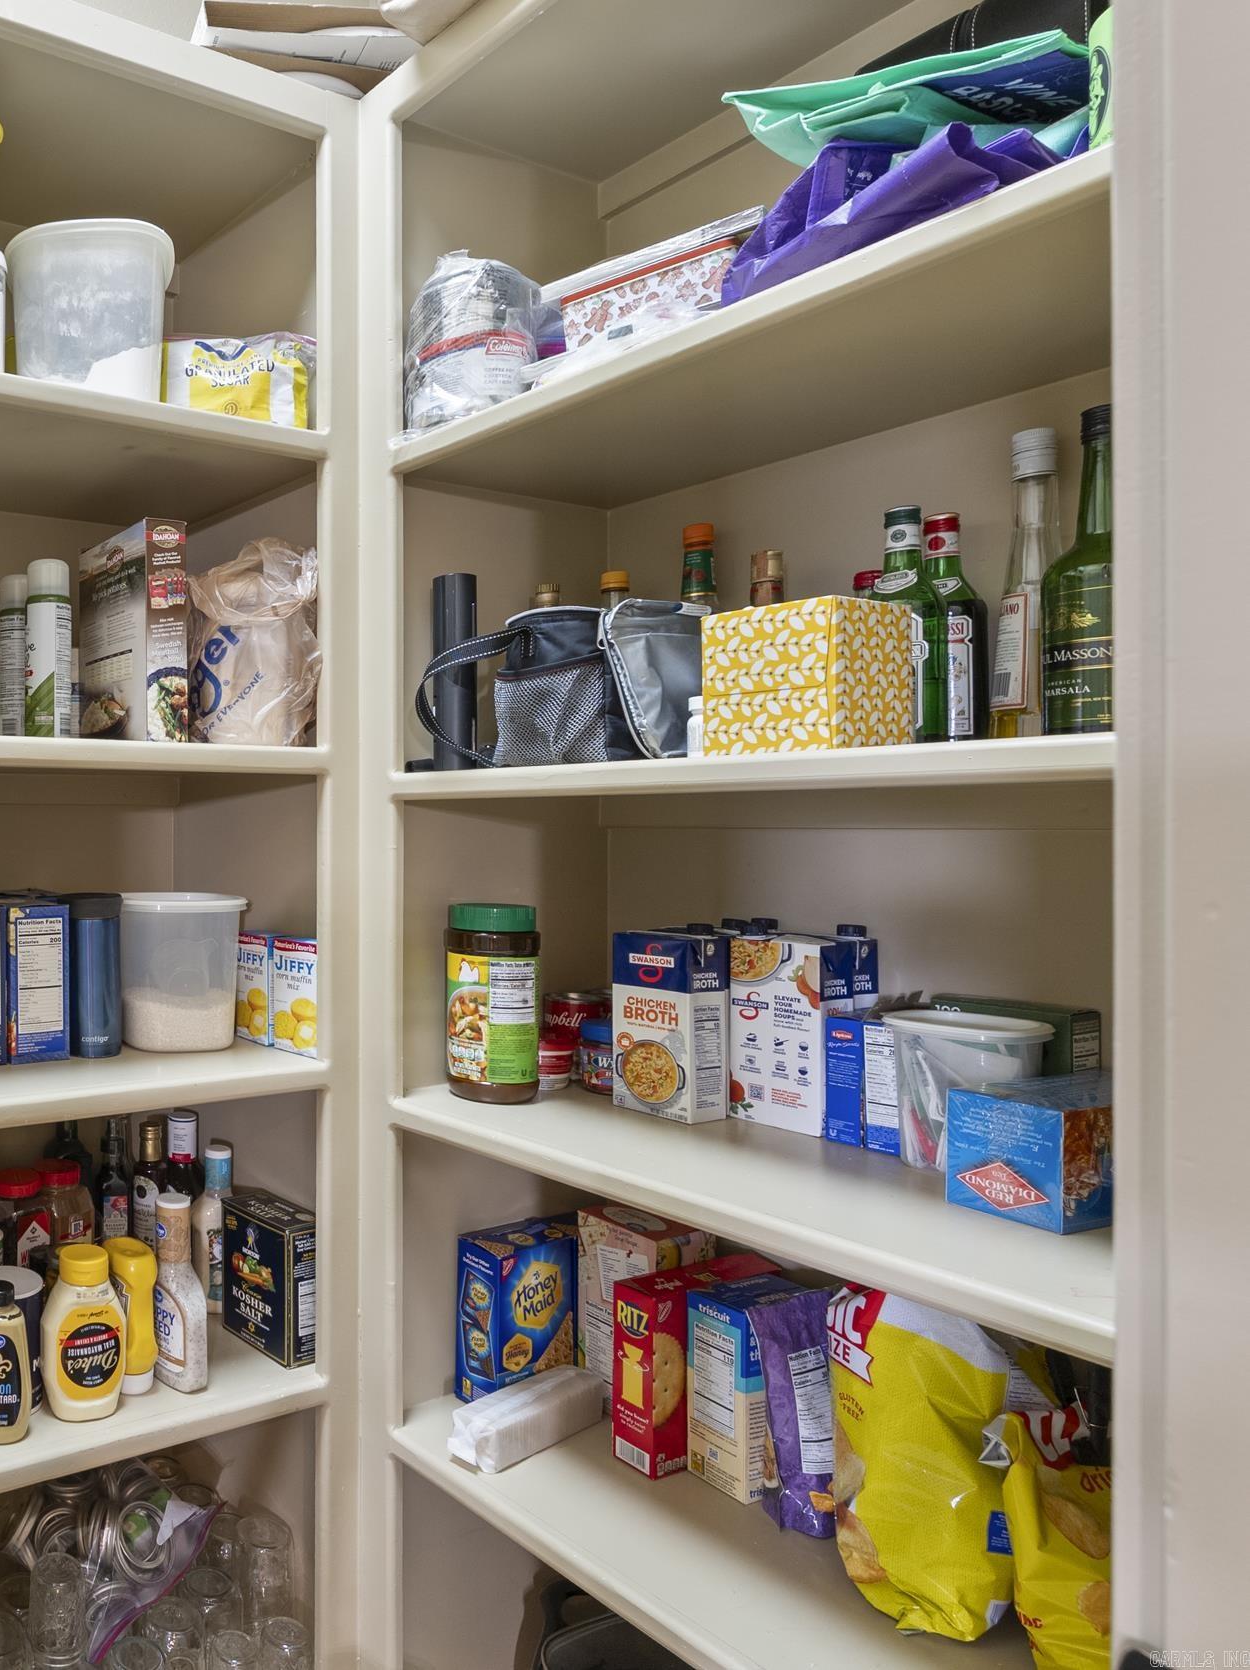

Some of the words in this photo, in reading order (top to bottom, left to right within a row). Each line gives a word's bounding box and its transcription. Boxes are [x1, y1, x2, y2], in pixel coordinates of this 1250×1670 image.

[153, 533, 179, 541] IDAHOAN
[156, 641, 182, 649] Swedish
[1054, 646, 1113, 662] MASSON
[1044, 685, 1090, 697] MARSALA
[274, 940, 295, 949] America's
[296, 943, 316, 953] Favorite
[237, 947, 264, 967] JIFFY
[275, 954, 314, 975] JIFFY
[631, 955, 672, 966] SWANSON
[276, 972, 290, 981] corn
[291, 974, 312, 985] muffin
[287, 983, 300, 991] mix
[627, 996, 676, 1012] CHICKEN
[733, 999, 768, 1009] SWANSON
[774, 995, 801, 1003] ELEVATE
[623, 1005, 679, 1027] BROTH
[774, 1007, 812, 1017] HOMEMADE
[774, 1012, 795, 1020] SOUPS
[832, 1031, 852, 1039] Lipton
[966, 1174, 1036, 1201] DIAMOND
[985, 1188, 1014, 1204] RED
[248, 1200, 291, 1221] KOSHER
[242, 1246, 260, 1260] MORTON
[515, 1271, 558, 1308] Honey
[232, 1285, 273, 1318] KOSHER
[522, 1289, 555, 1321] Maid
[586, 1301, 604, 1312] Nutrition
[156, 1306, 175, 1326] PPY
[240, 1302, 263, 1322] SALT
[617, 1300, 649, 1336] RITZ
[699, 1304, 731, 1324] triscuit
[695, 1324, 717, 1338] Nutrition
[718, 1331, 734, 1345] Facts
[67, 1344, 103, 1357] MAYONNAISE
[103, 1339, 115, 1349] REAL
[67, 1349, 118, 1374] Duke's
[504, 1349, 529, 1361] Honey
[695, 1344, 712, 1355] Calories
[723, 1354, 734, 1365] 110
[789, 1351, 809, 1361] Nutrition
[794, 1378, 812, 1386] Calories
[839, 1391, 865, 1416] GLUTEN
